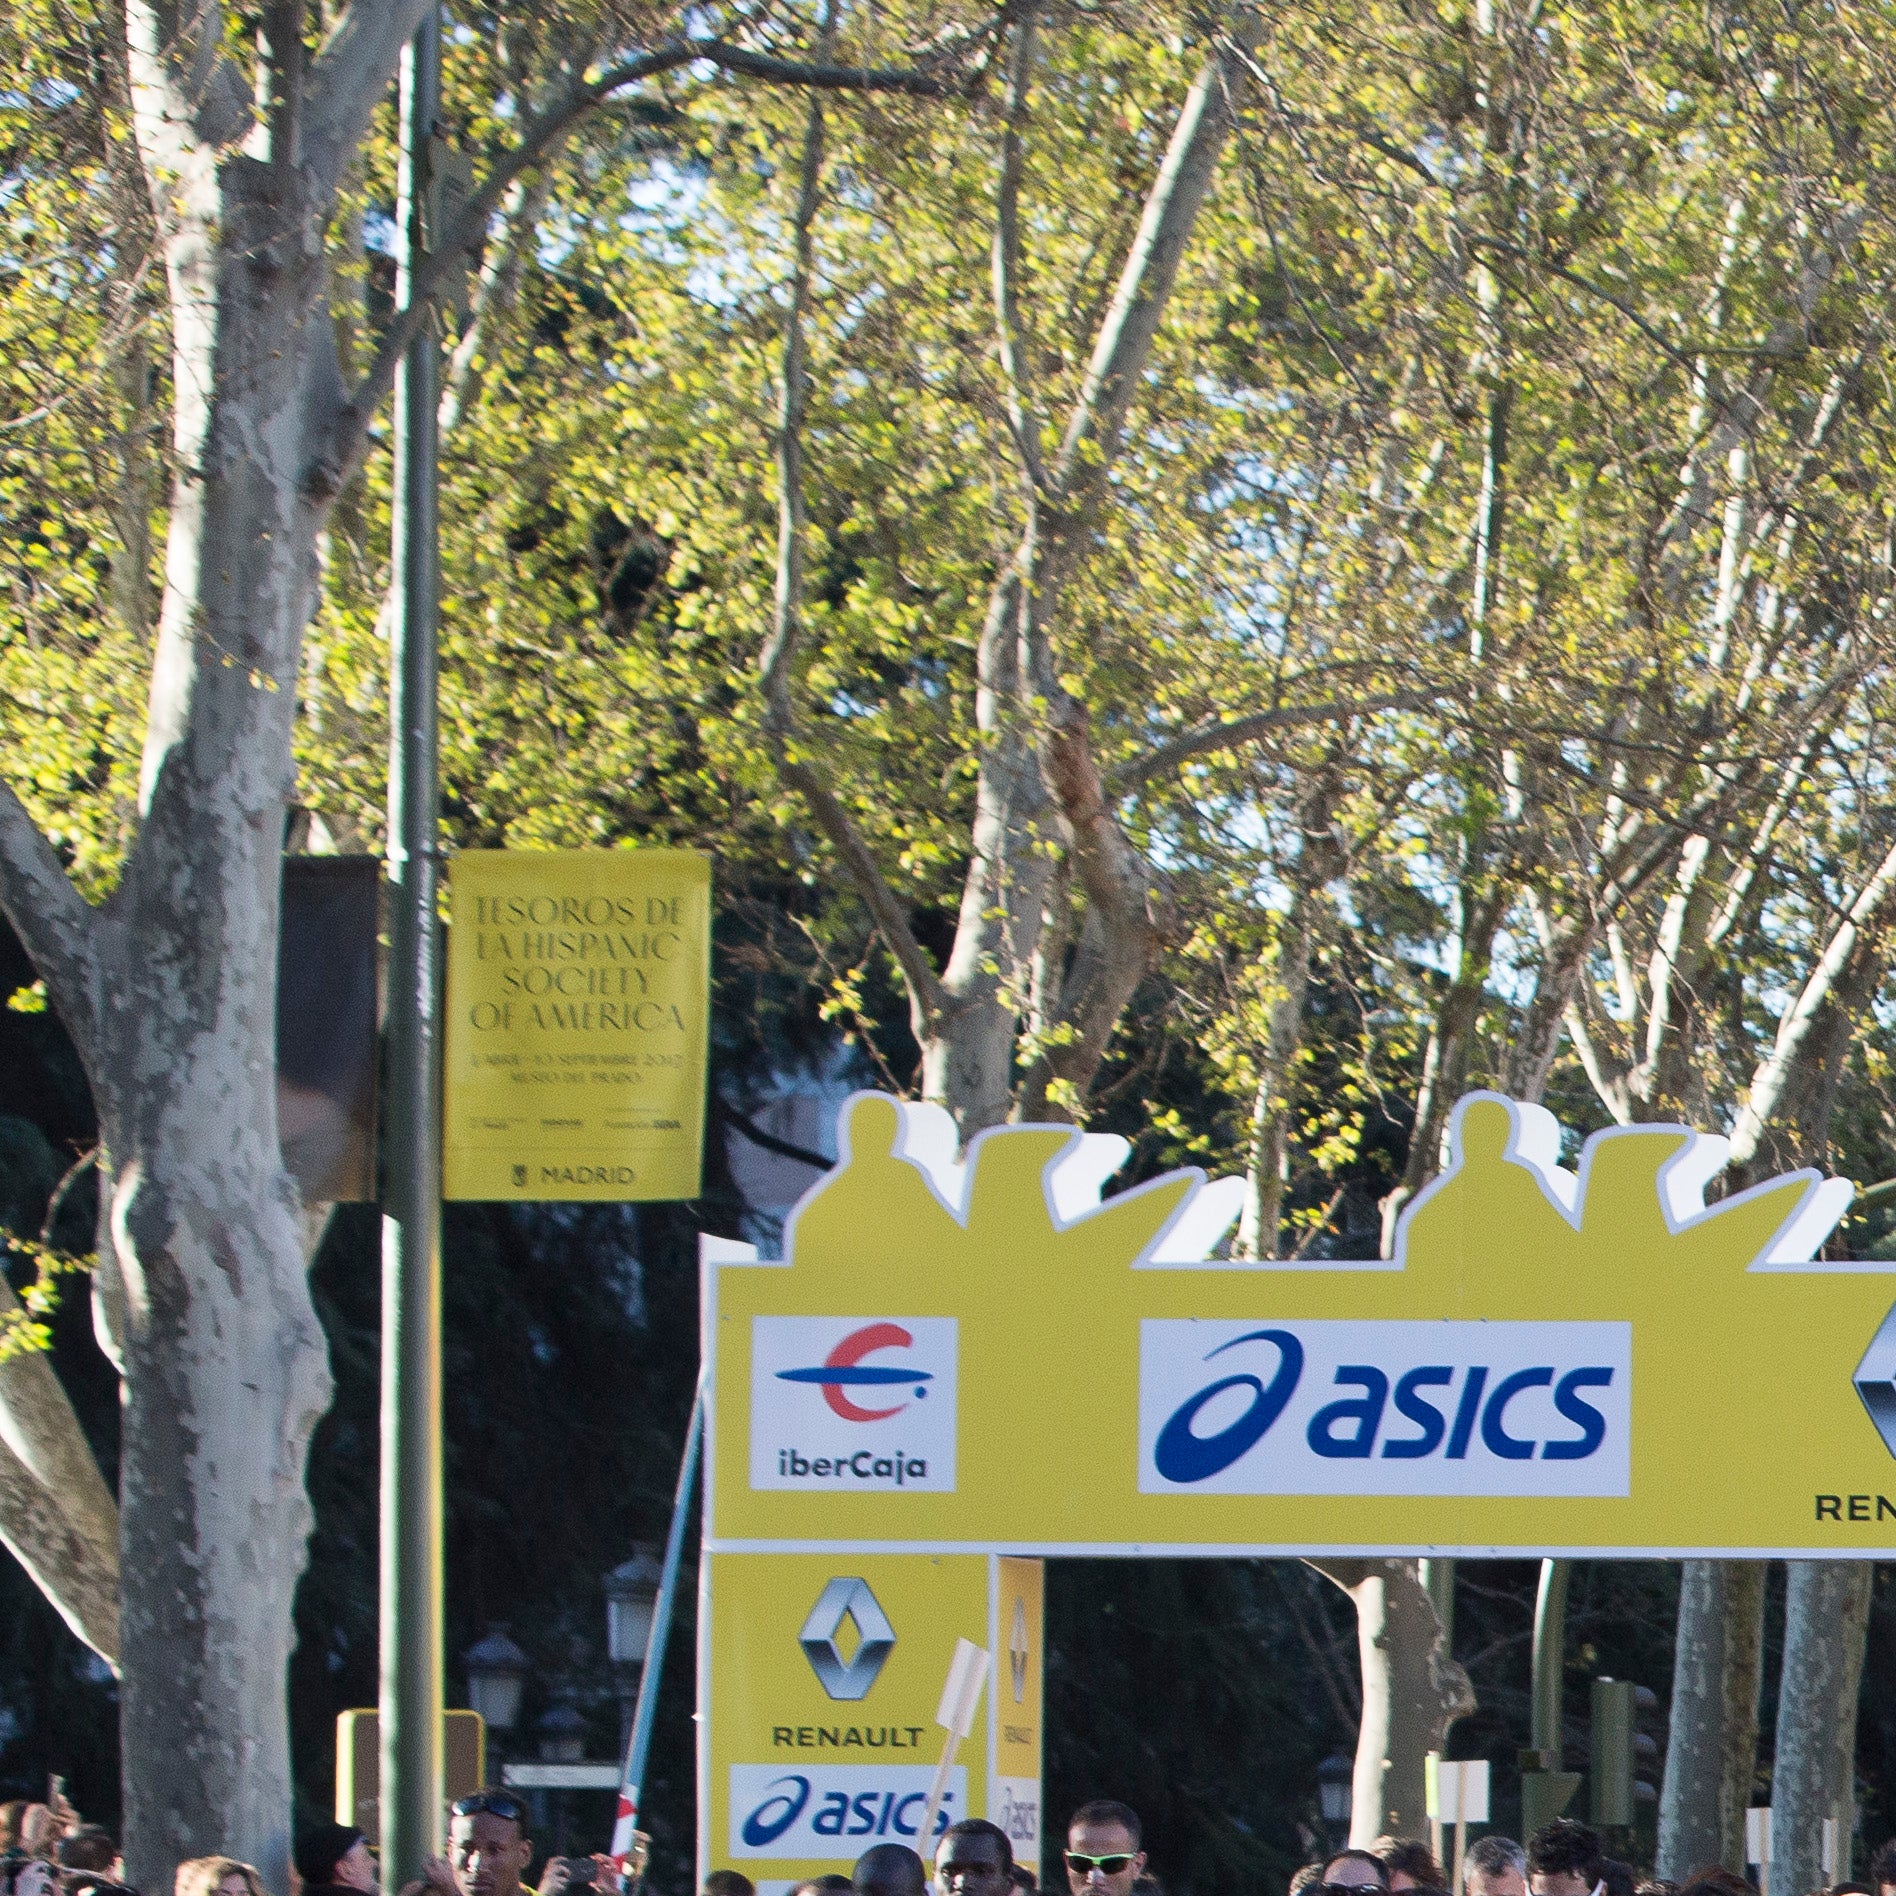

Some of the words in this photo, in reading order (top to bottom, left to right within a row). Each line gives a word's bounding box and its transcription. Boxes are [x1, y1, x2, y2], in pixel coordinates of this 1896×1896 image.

[477, 897, 634, 925] TESOROS
[648, 897, 682, 925] DE
[478, 932, 512, 960] LA
[523, 932, 680, 961] HISPANIC
[503, 967, 647, 995] SOCIETY
[471, 1002, 515, 1031] OF
[530, 1002, 684, 1031] AMERICA
[541, 1167, 635, 1184] MADRID
[1306, 1365, 1615, 1459] asics
[778, 1450, 926, 1484] iberCaja
[772, 1727, 924, 1748] RENAULT
[811, 1792, 955, 1836] asics
